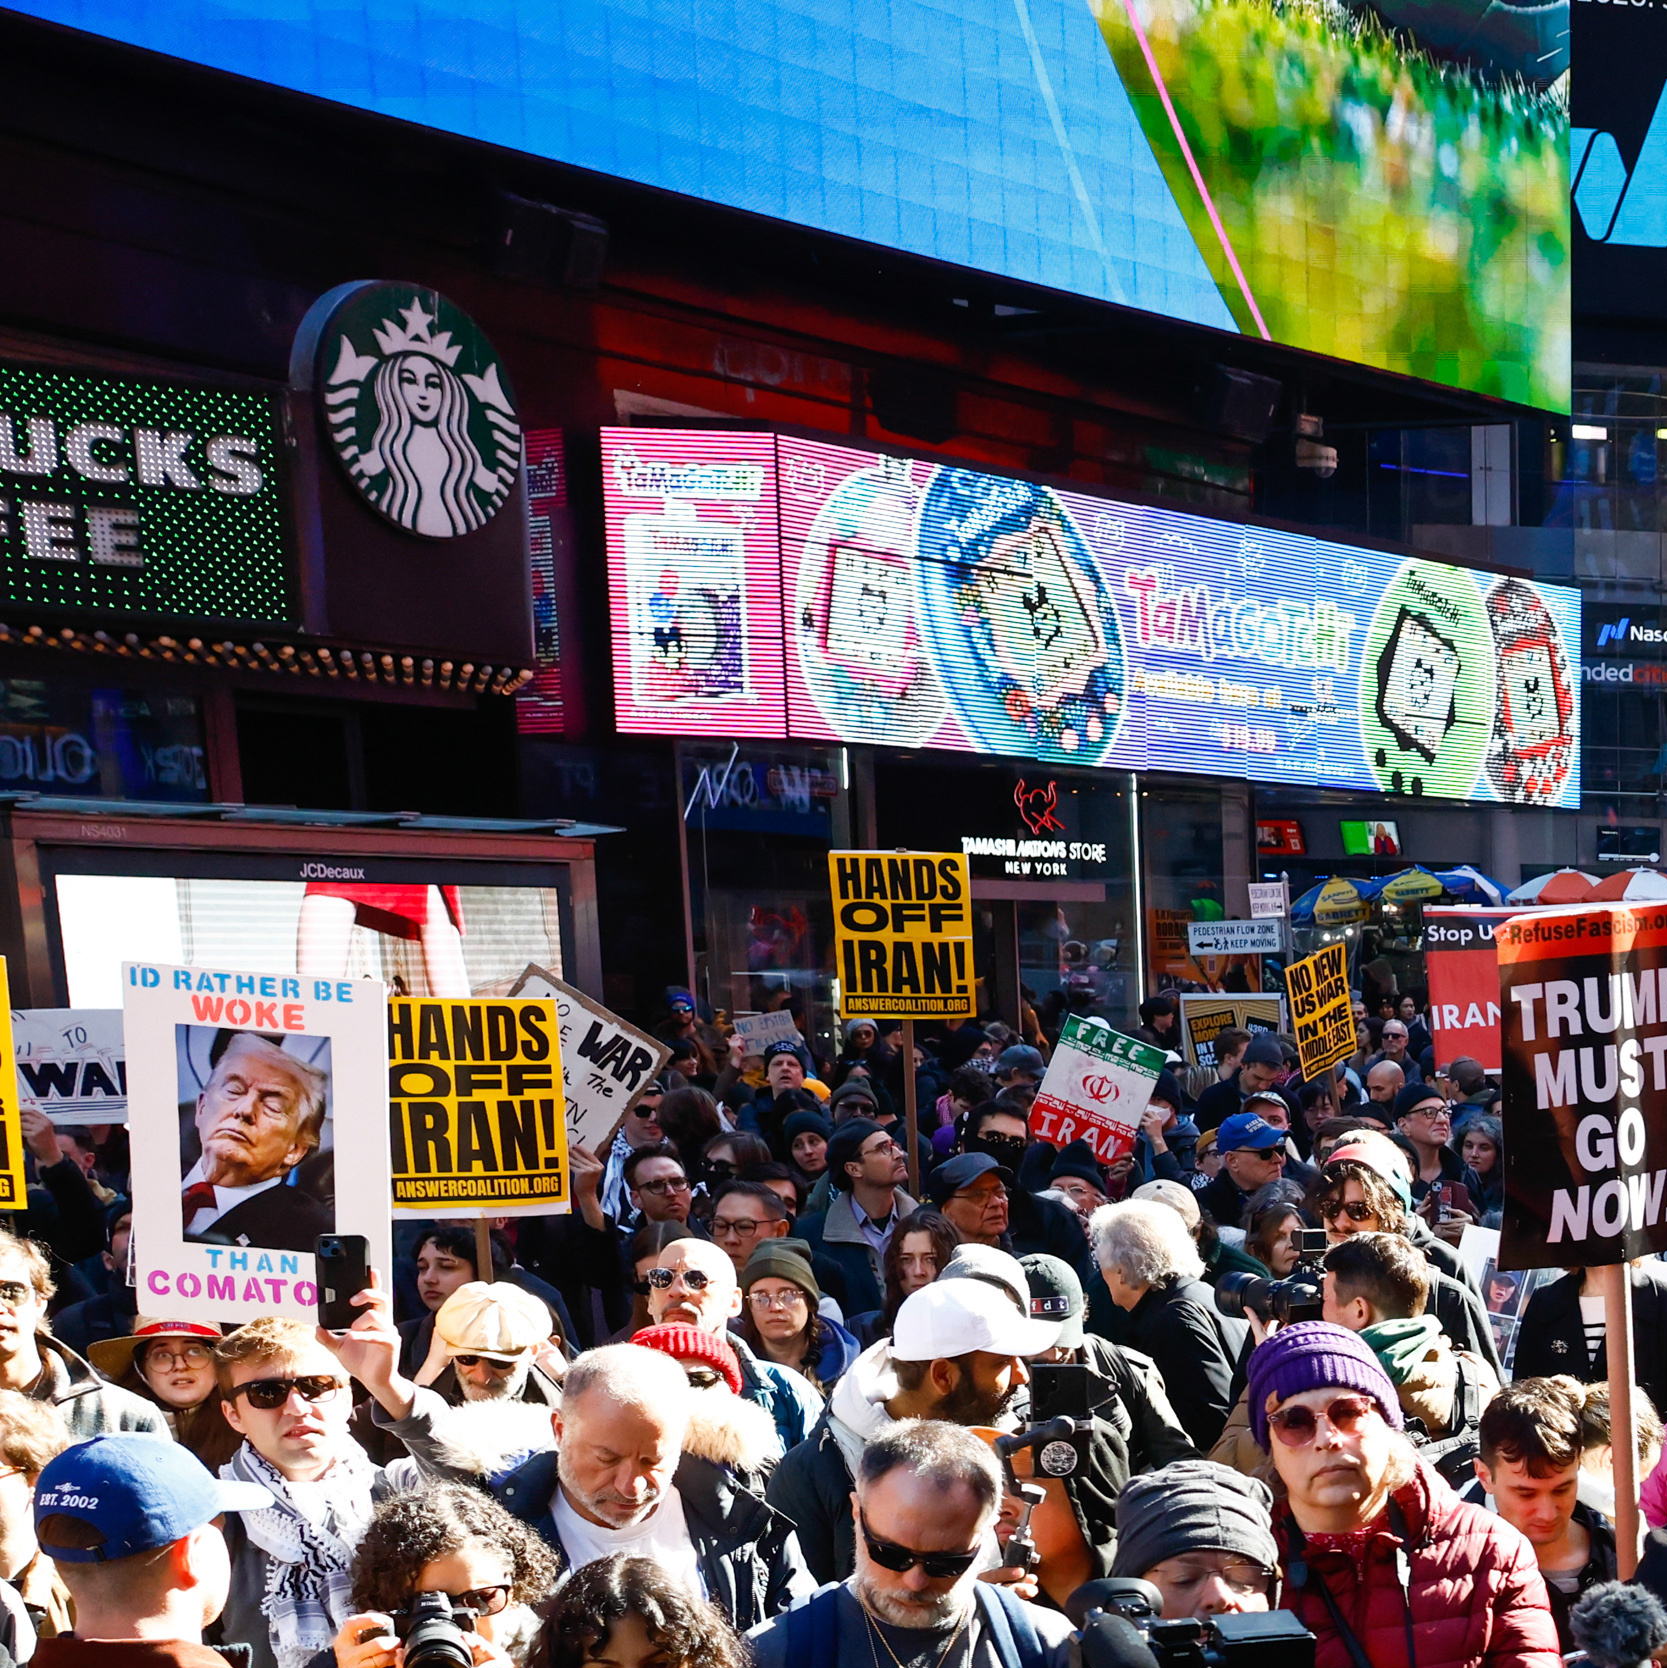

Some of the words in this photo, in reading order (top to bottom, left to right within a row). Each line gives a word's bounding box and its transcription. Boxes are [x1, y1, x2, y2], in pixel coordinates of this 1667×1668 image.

[1069, 842, 1107, 863] STORE
[299, 863, 365, 880] JCDecaux
[837, 858, 961, 900] HANDS
[1005, 861, 1031, 875] NEW
[1034, 862, 1067, 876] YORK
[840, 902, 964, 933] OFF
[1193, 926, 1236, 936] PEDESTRIAN
[1237, 925, 1254, 935] FLOW
[1257, 925, 1275, 934] ZONE
[1230, 939, 1248, 948] KEEP
[1250, 938, 1276, 947] MOVING
[1428, 924, 1473, 944] Stop
[844, 938, 967, 994] IRAN!
[1289, 964, 1312, 998] NO
[1313, 947, 1343, 982] NEW
[172, 968, 300, 999] RATHER
[313, 979, 353, 1003] BE
[1294, 994, 1316, 1019] US
[1317, 976, 1346, 1007] WAR
[191, 995, 306, 1031] WOKE
[847, 997, 969, 1013] ANSWERCOALITION.ORG
[1190, 1013, 1233, 1031] EXPLORE
[1298, 1022, 1319, 1043] IN
[1320, 1002, 1348, 1030] THE
[577, 1023, 652, 1091] WAR
[1076, 1022, 1145, 1061] FREE
[1576, 1107, 1646, 1173] GO
[205, 1249, 299, 1275] THAN
[40, 1494, 58, 1511] EST.
[61, 1494, 98, 1511] 2002
